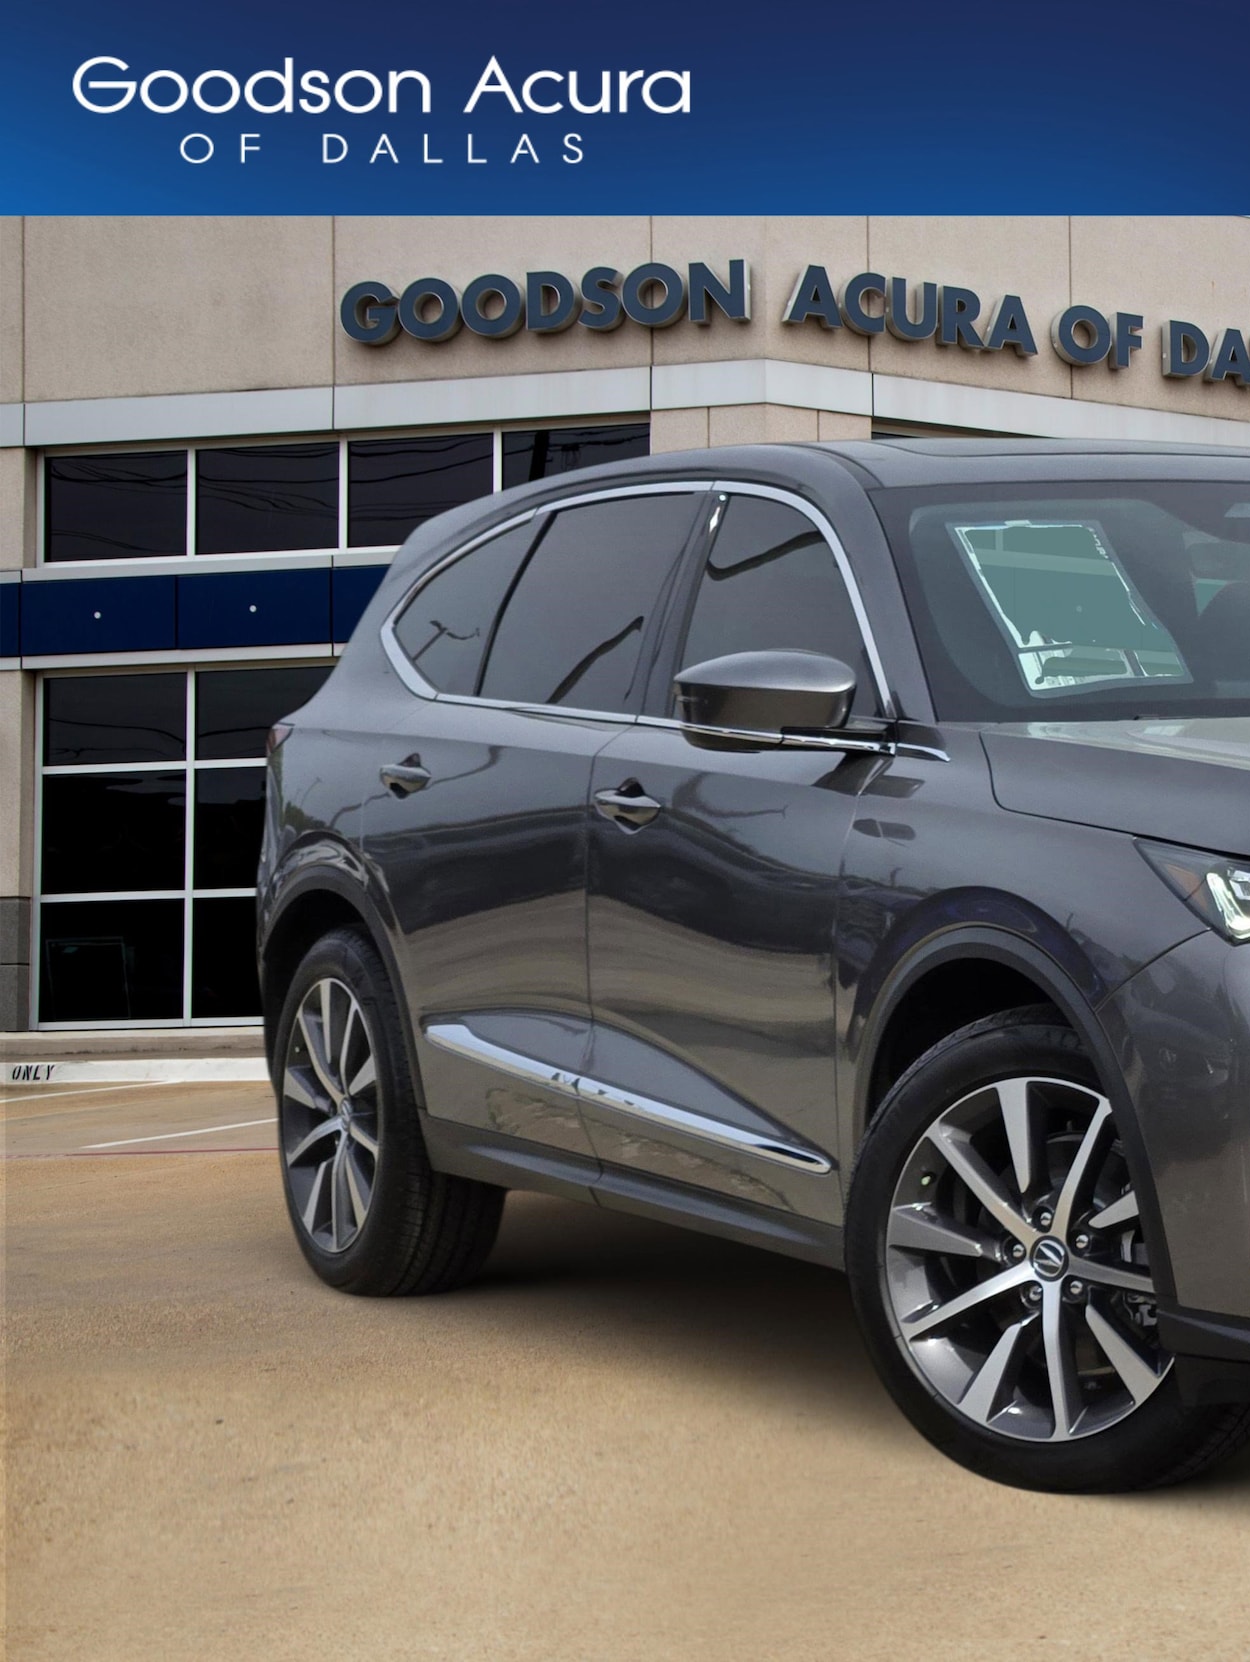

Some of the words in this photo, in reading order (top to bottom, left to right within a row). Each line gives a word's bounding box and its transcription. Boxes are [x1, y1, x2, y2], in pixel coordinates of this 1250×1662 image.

[340, 259, 751, 346] GOODSON
[782, 264, 1038, 357] ACURA
[1051, 304, 1144, 370] OF
[12, 1064, 55, 1080] ONLY
